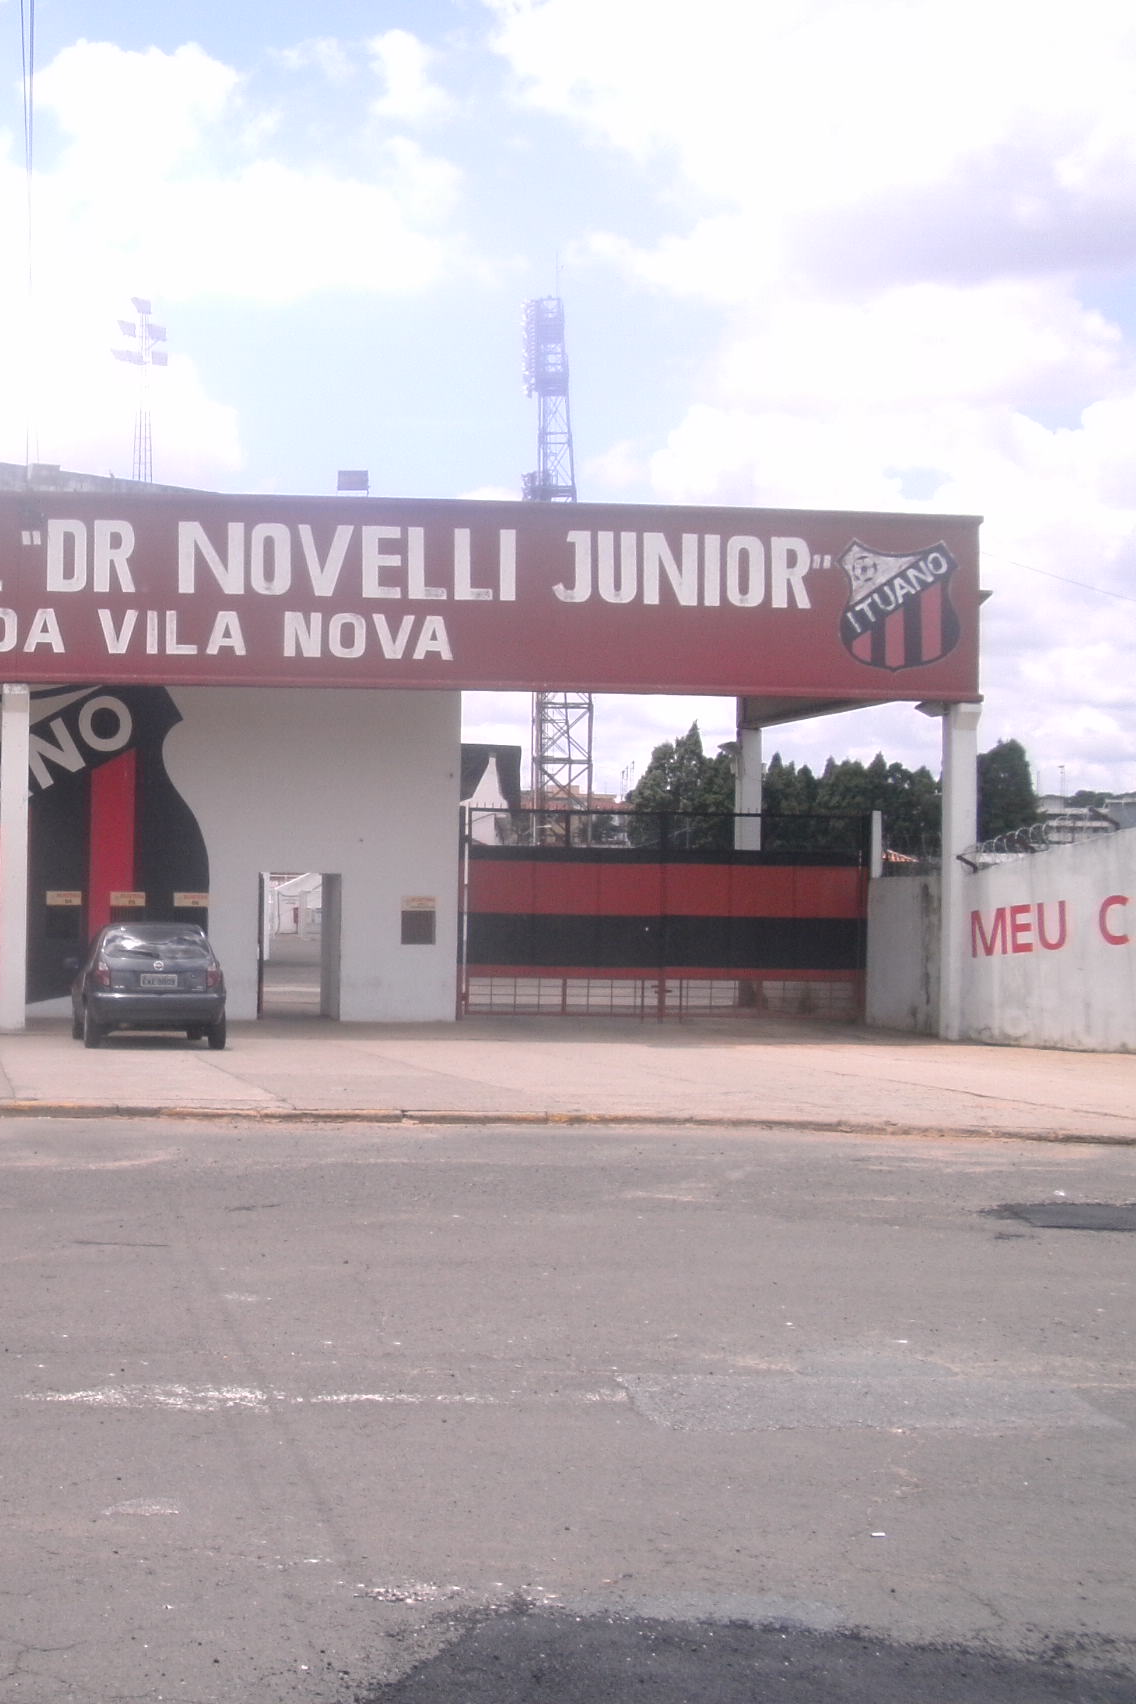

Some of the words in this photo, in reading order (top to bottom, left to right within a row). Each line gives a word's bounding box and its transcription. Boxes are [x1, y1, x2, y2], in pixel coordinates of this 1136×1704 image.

[177, 521, 517, 601] NOVELLI
[846, 552, 948, 633] ITUANO
[97, 609, 247, 656] VILA
[283, 611, 454, 661] NOVA
[971, 900, 1067, 958] MEU
